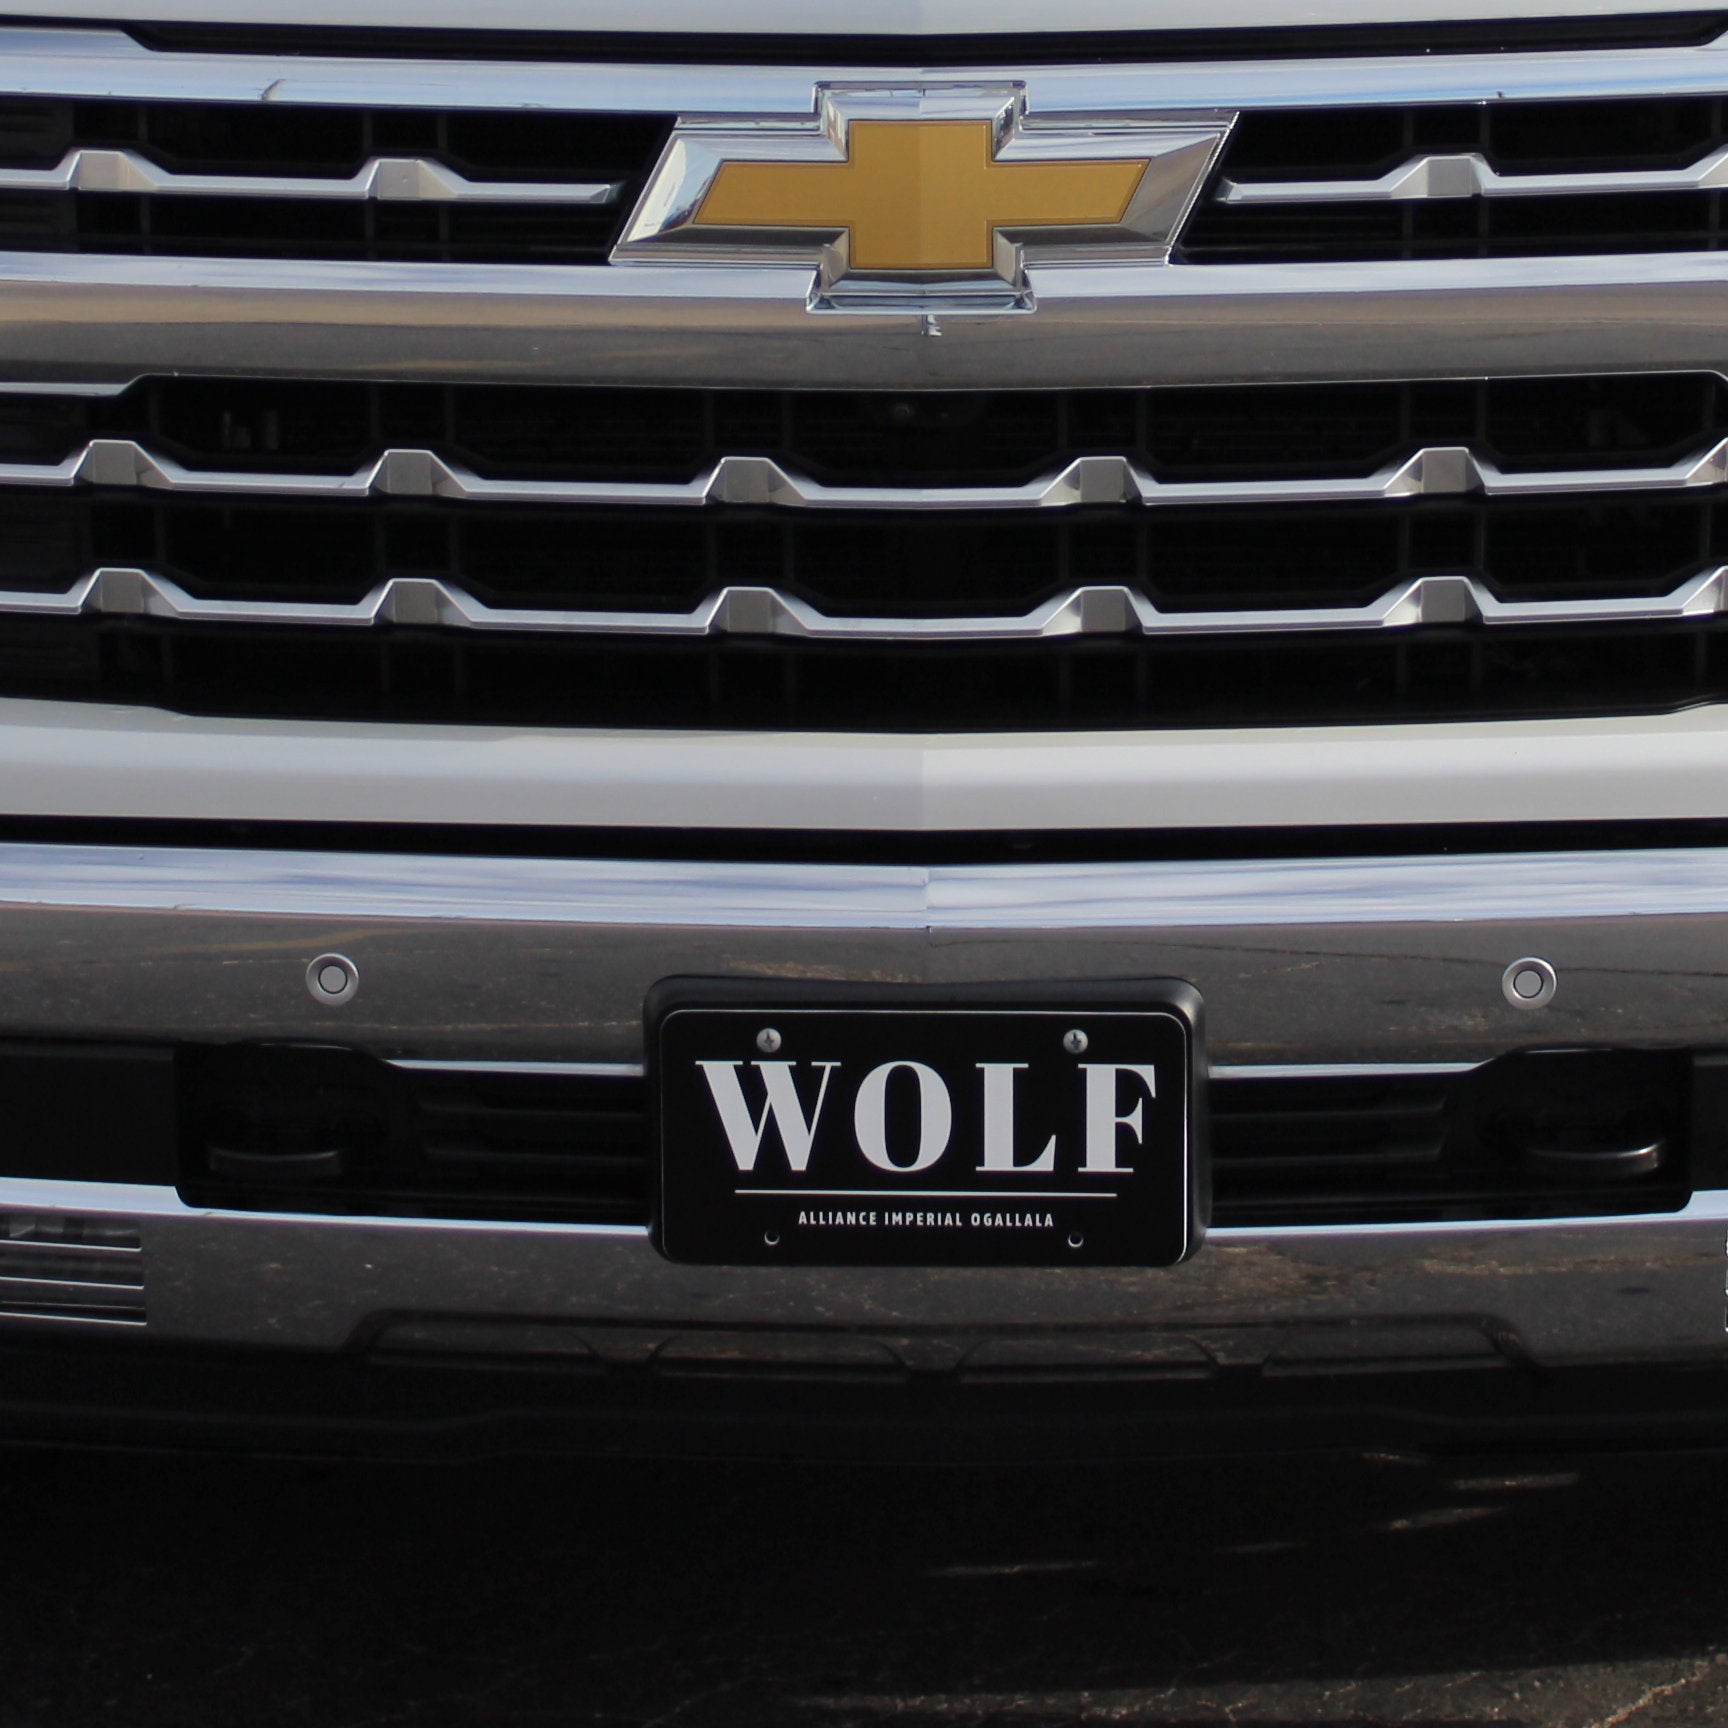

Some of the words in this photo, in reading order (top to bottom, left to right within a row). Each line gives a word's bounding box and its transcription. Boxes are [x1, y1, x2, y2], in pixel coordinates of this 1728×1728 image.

[694, 1059, 1158, 1173] WOLF
[797, 1209, 878, 1227] ALLIANCE
[884, 1210, 964, 1228] IMPERIAL
[970, 1211, 1055, 1229] OGALLALA
